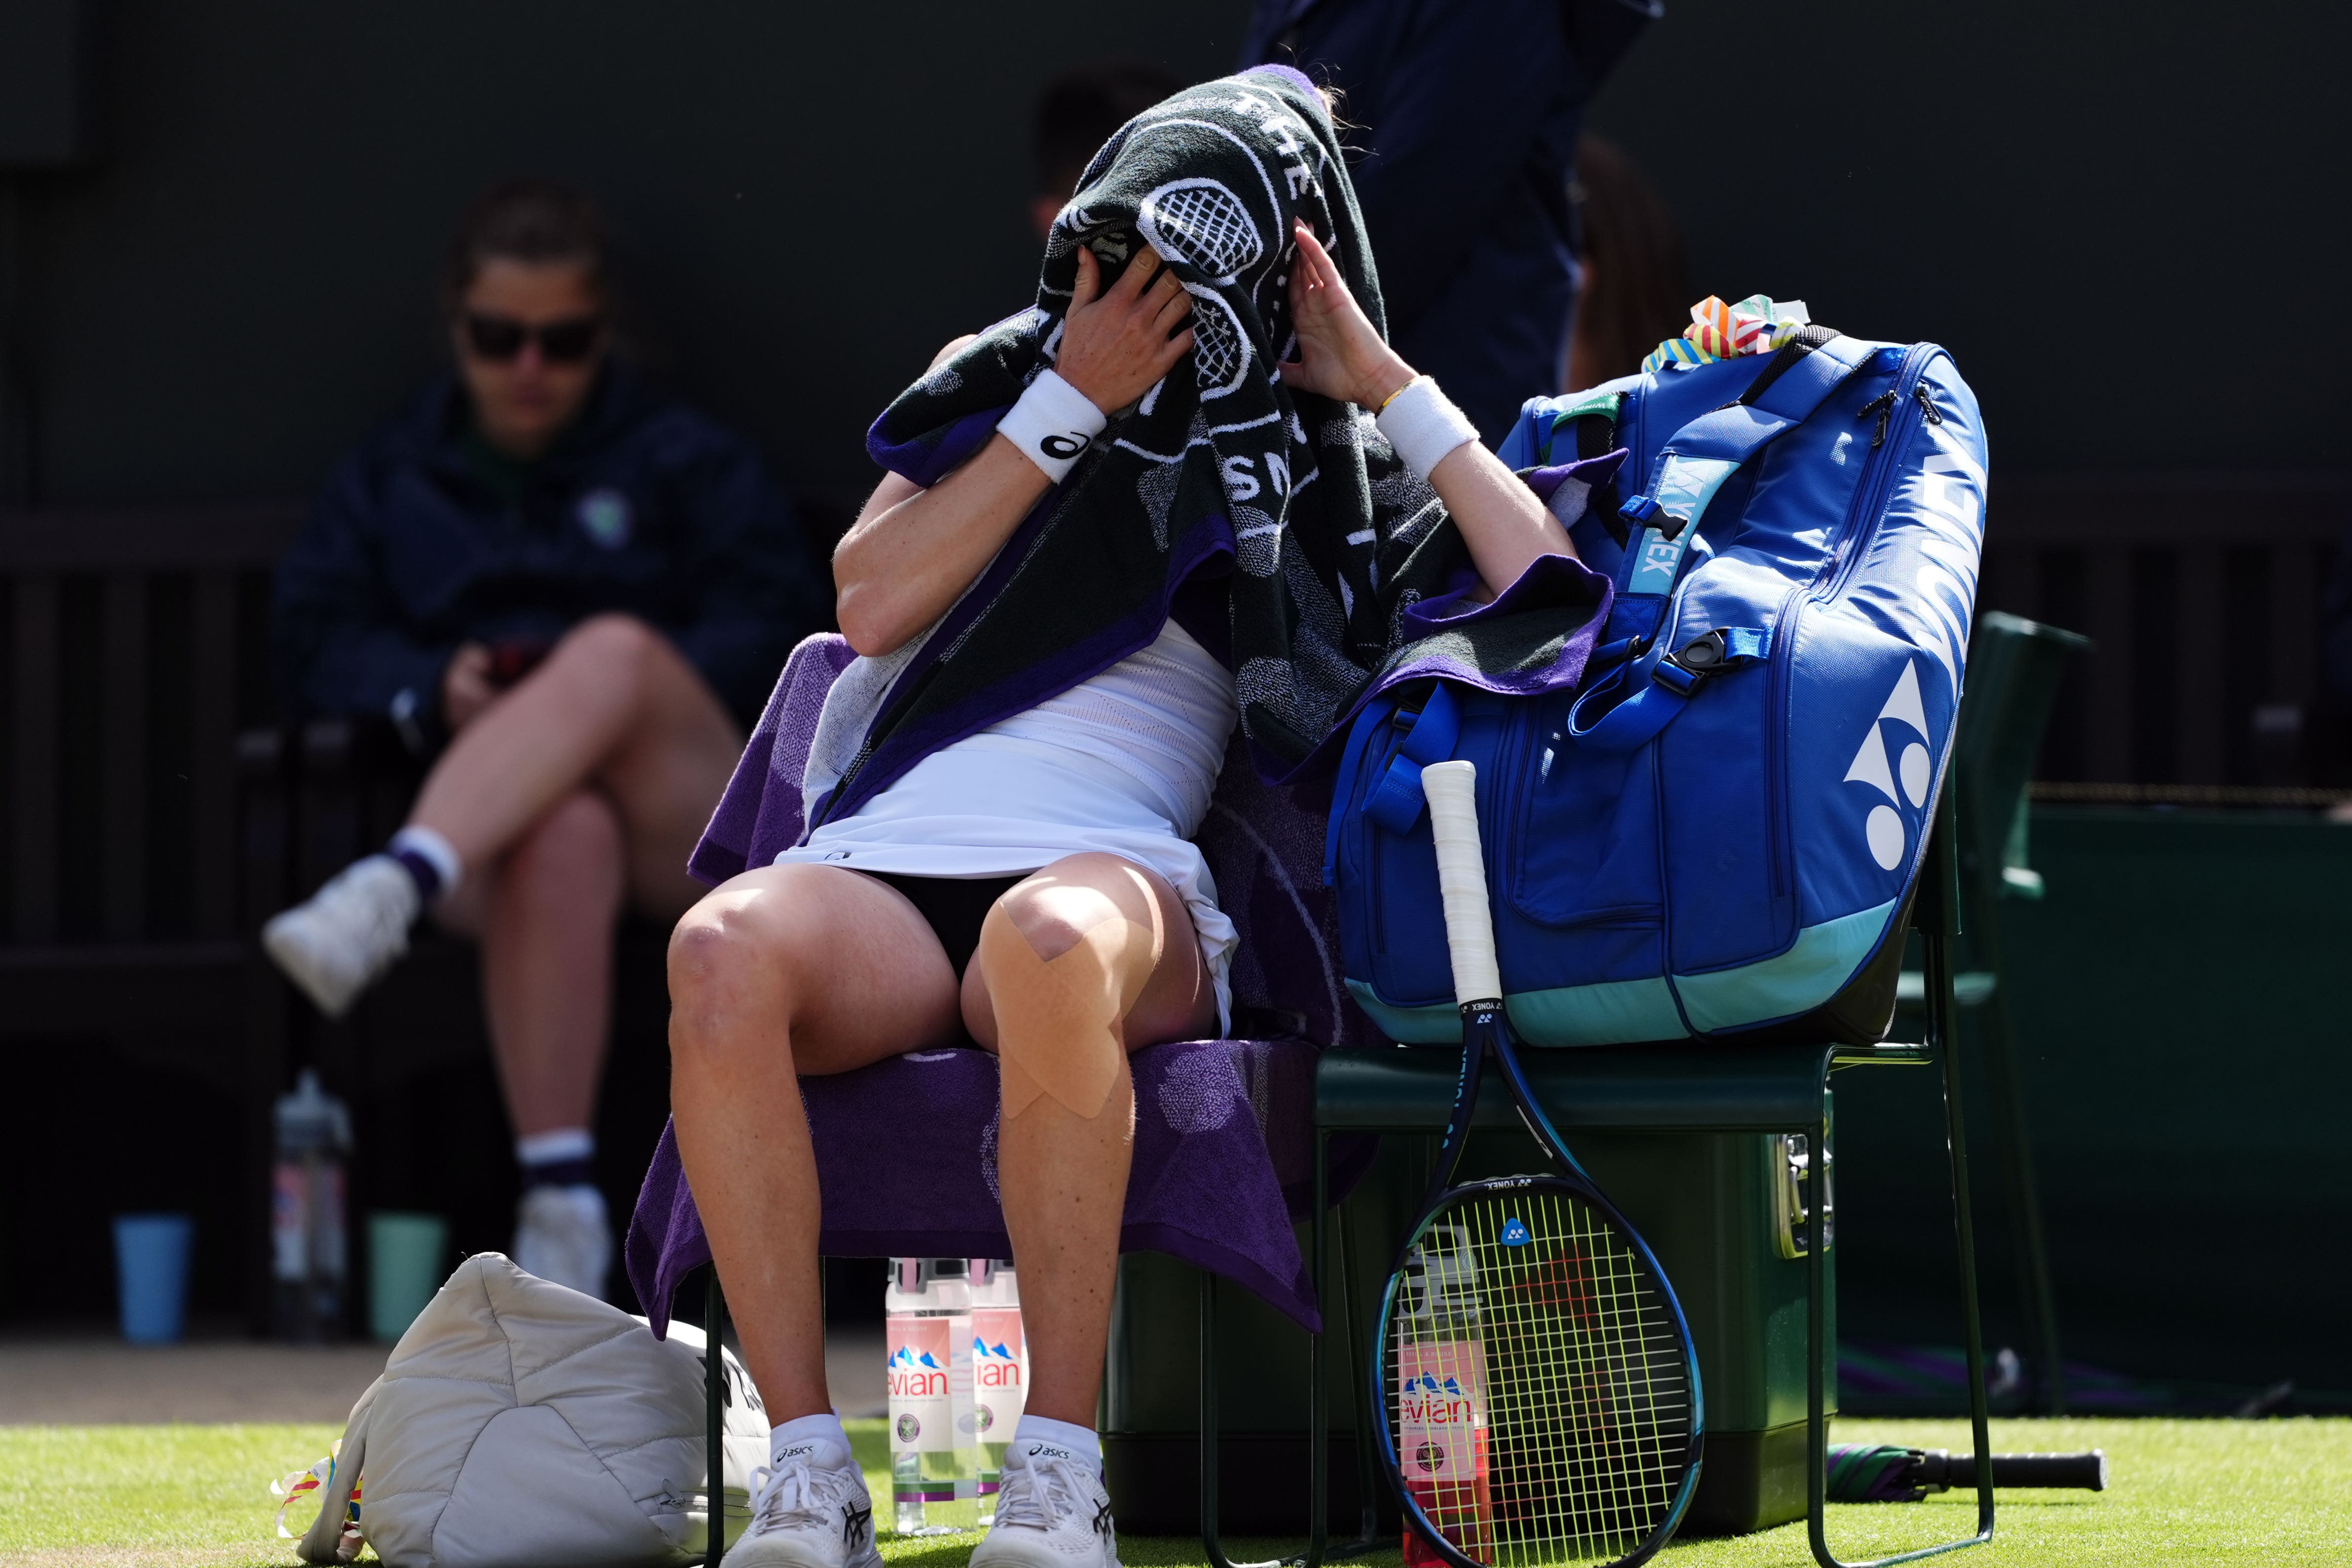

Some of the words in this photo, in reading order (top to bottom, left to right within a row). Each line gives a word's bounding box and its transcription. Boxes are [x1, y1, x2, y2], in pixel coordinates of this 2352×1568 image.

[1554, 402, 1605, 422] WIMBLED
[1472, 1002, 1495, 1011] YONEX
[1487, 1179, 1515, 1191] YONEX
[1400, 1393, 1471, 1424] evian
[1043, 1448, 1069, 1459] asics
